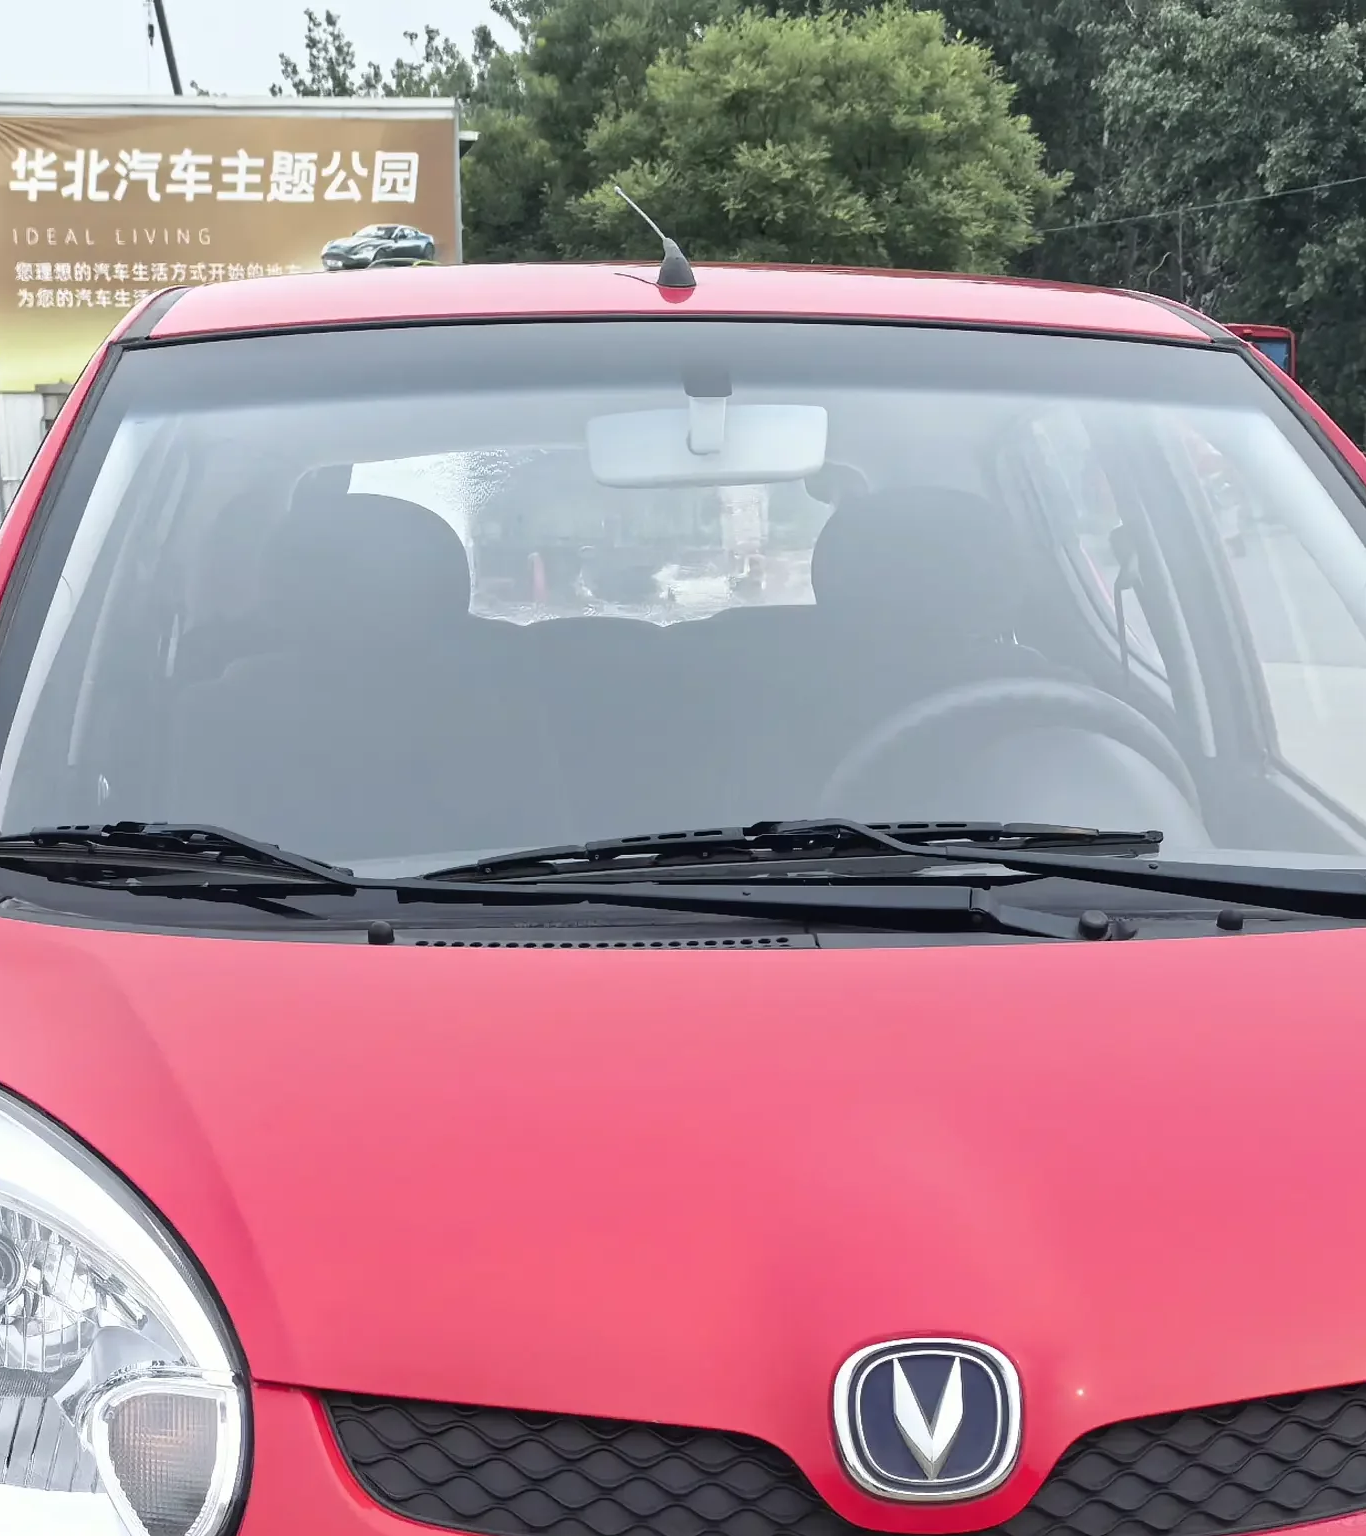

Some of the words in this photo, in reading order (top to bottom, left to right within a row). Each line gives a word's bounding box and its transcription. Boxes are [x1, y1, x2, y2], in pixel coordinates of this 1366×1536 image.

[8, 148, 421, 204] 华北汽车主题公园
[12, 228, 95, 246] IDEAL
[115, 228, 213, 246] LIVING
